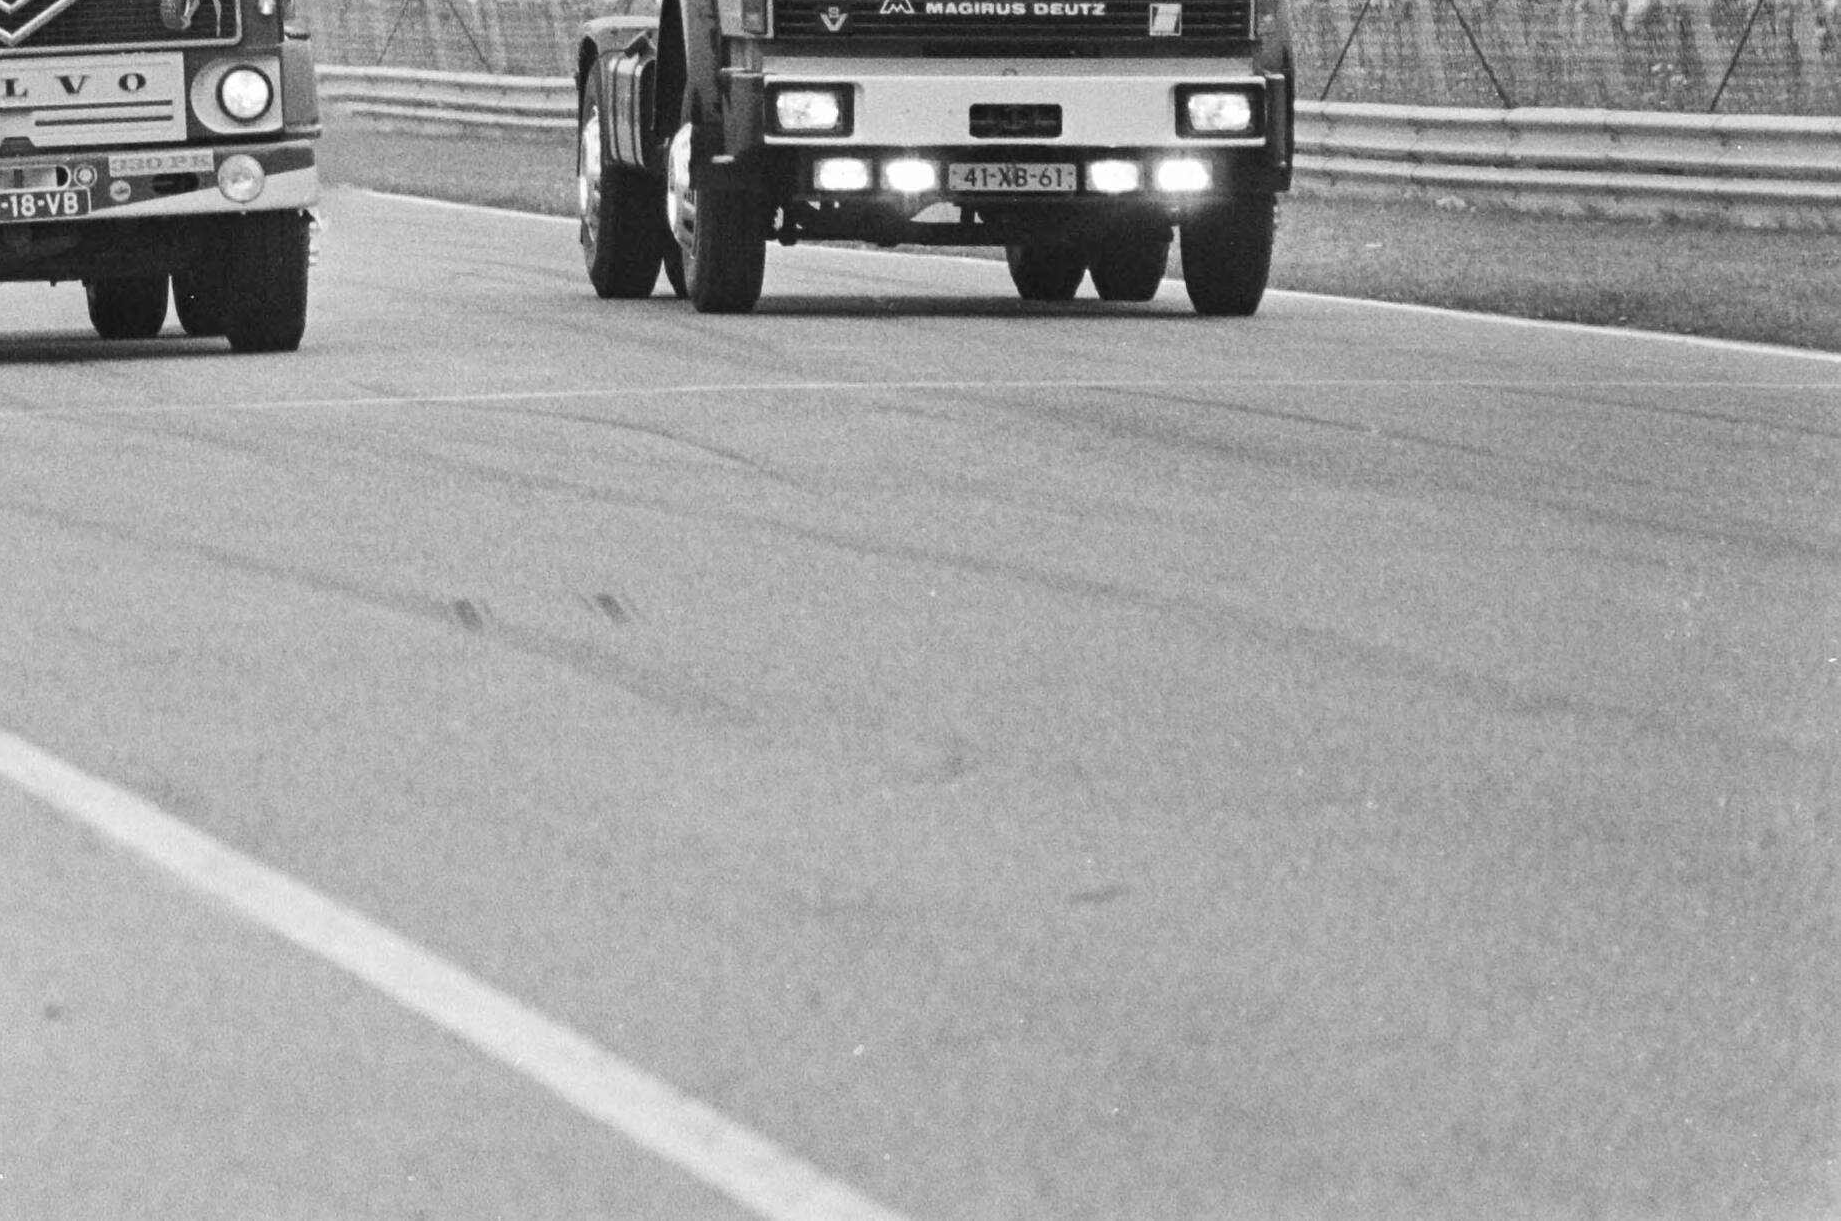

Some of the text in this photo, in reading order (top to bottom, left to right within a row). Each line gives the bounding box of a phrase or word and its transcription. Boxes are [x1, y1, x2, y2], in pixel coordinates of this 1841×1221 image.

[925, 2, 1107, 16] MAGIRUS DEUTZ
[964, 166, 1063, 188] 41-XB-61
